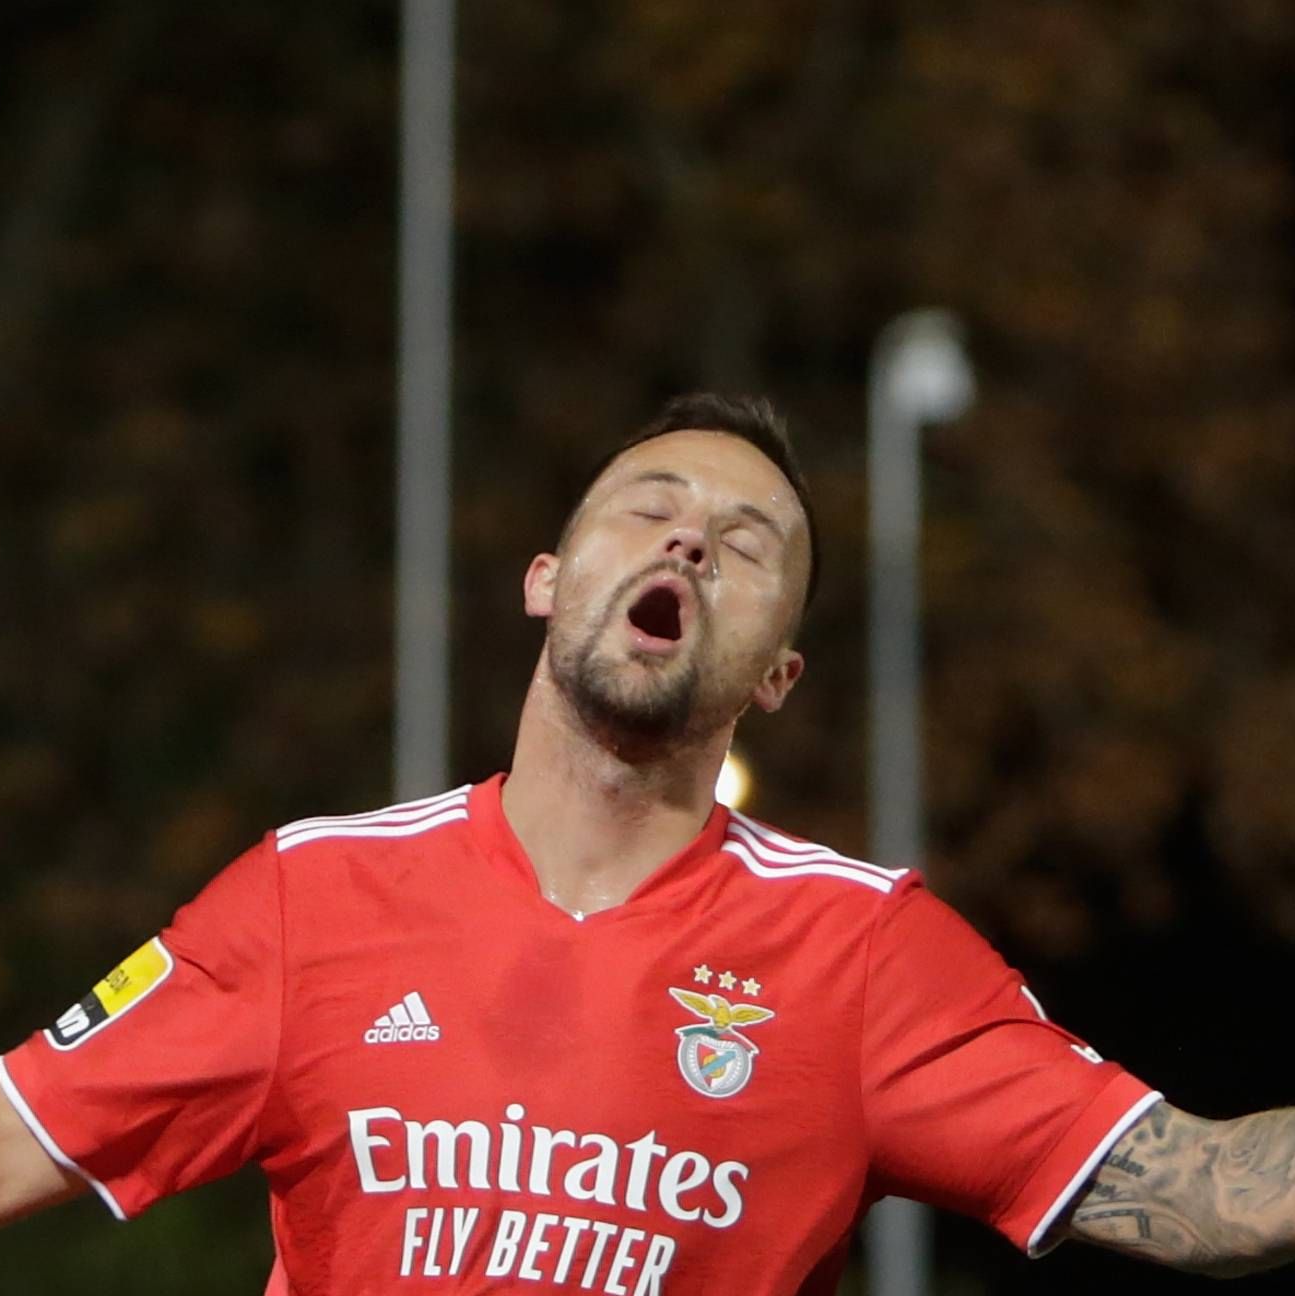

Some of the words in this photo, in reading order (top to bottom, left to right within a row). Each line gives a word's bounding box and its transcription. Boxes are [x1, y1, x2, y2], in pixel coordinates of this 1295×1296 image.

[364, 1023, 440, 1043] adidas
[347, 1103, 749, 1228] Emirates
[400, 1207, 480, 1276] FLY
